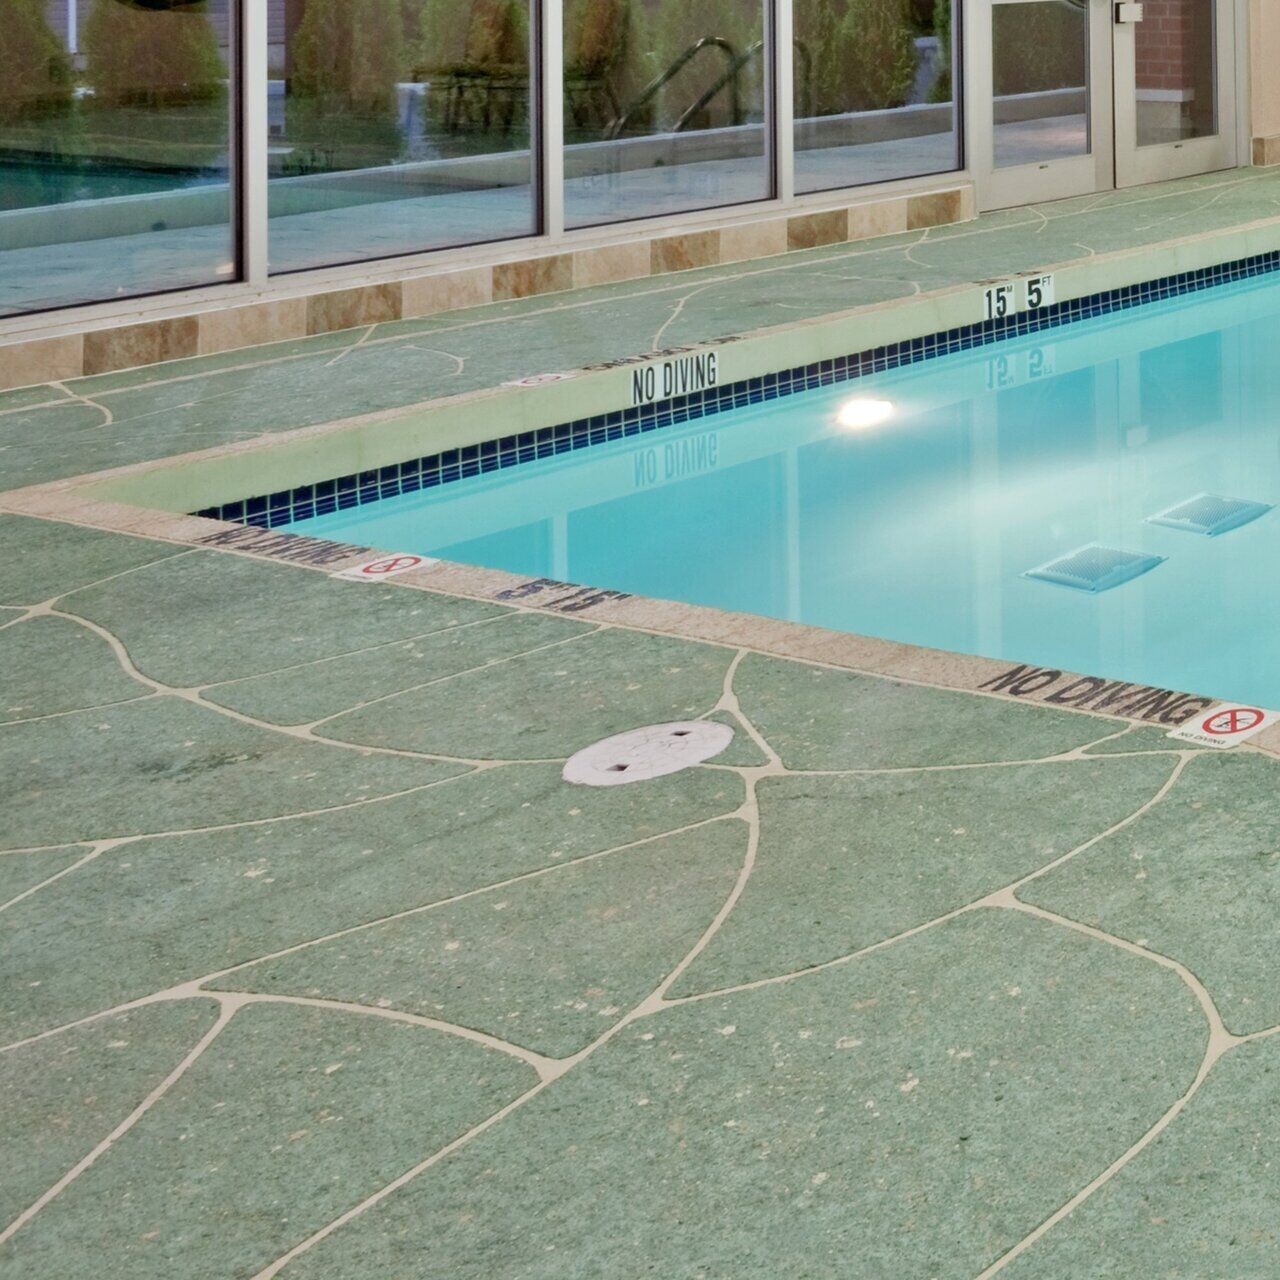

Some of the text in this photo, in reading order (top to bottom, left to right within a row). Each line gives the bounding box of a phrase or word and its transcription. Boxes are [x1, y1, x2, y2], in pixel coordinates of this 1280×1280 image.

[633, 366, 655, 405] NO
[664, 352, 716, 398] DIVING
[977, 664, 1213, 725] NO DIVING
